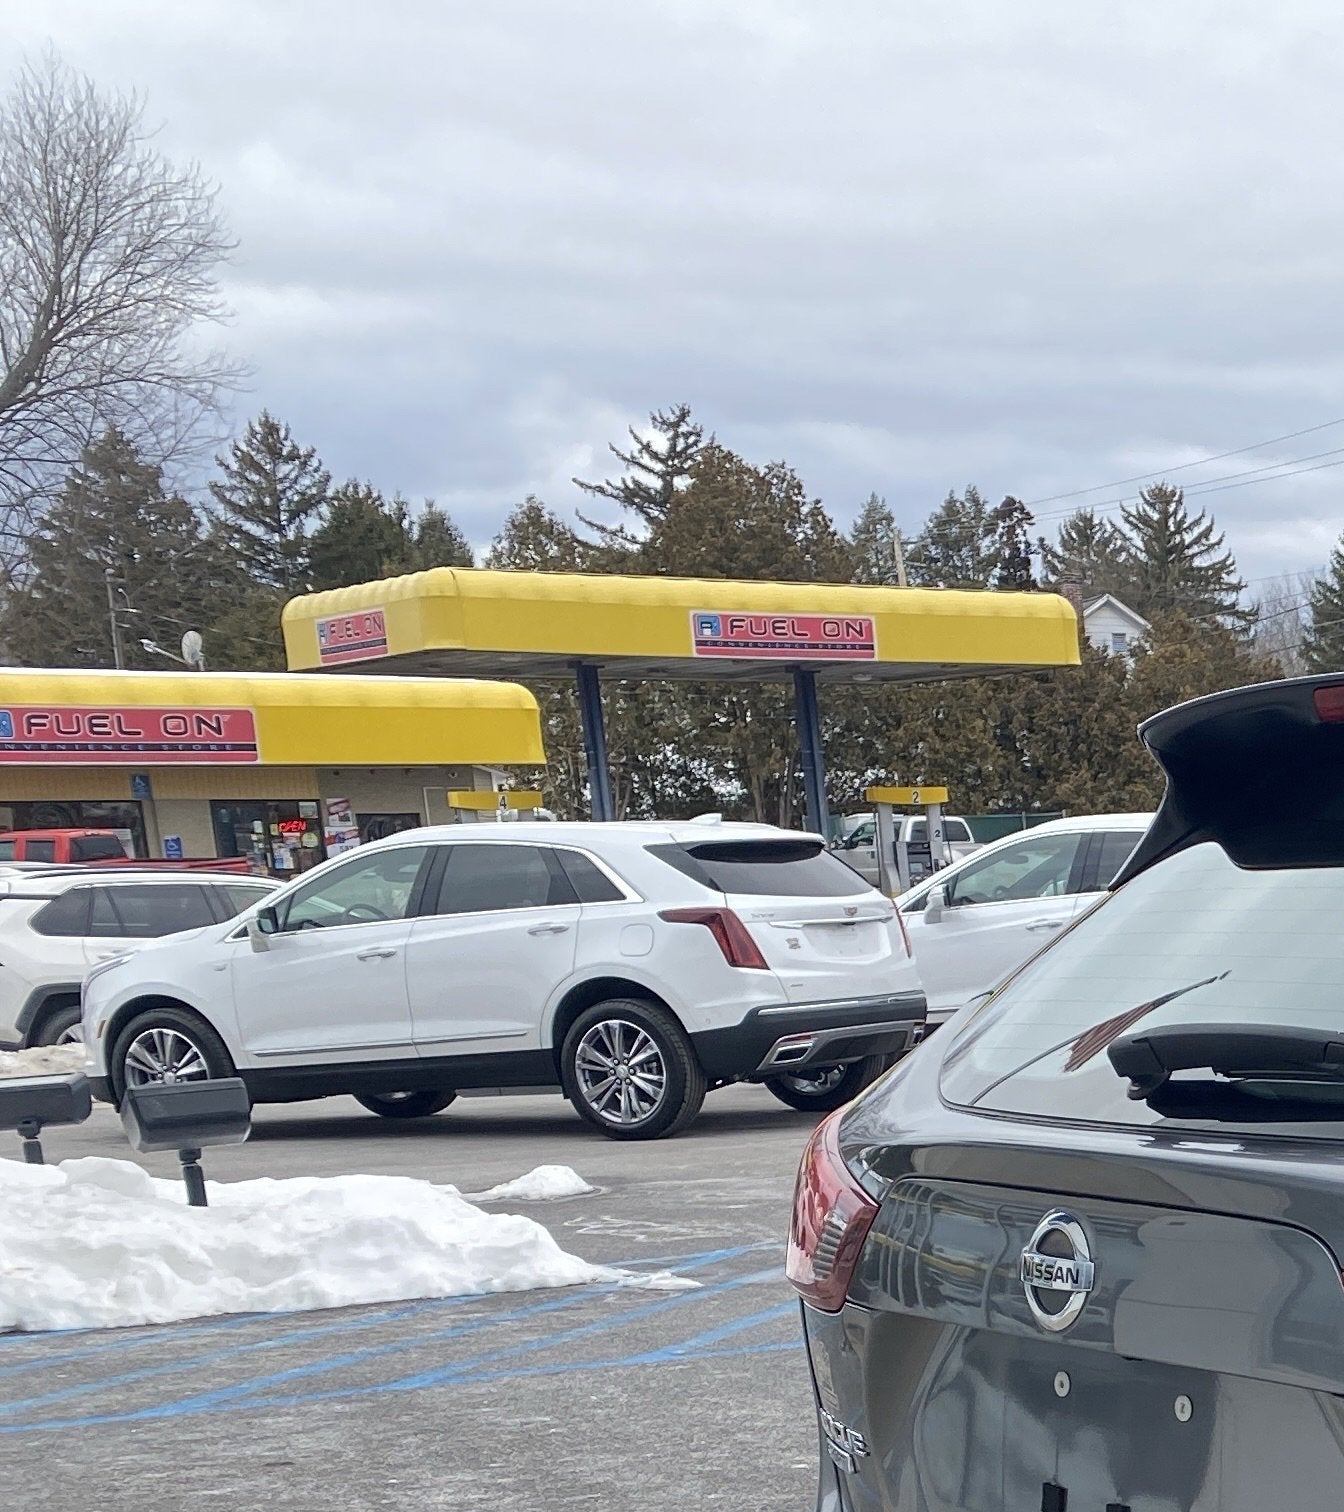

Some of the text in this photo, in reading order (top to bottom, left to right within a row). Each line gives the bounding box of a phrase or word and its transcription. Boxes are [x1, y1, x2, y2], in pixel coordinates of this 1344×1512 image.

[329, 619, 361, 639] FUEL
[728, 617, 865, 639] FUEL ON
[23, 712, 225, 738] FUEL ON
[4, 743, 232, 751] NVENIENCE STORE
[912, 791, 919, 803] 2
[1023, 1255, 1080, 1285] NISSAN
